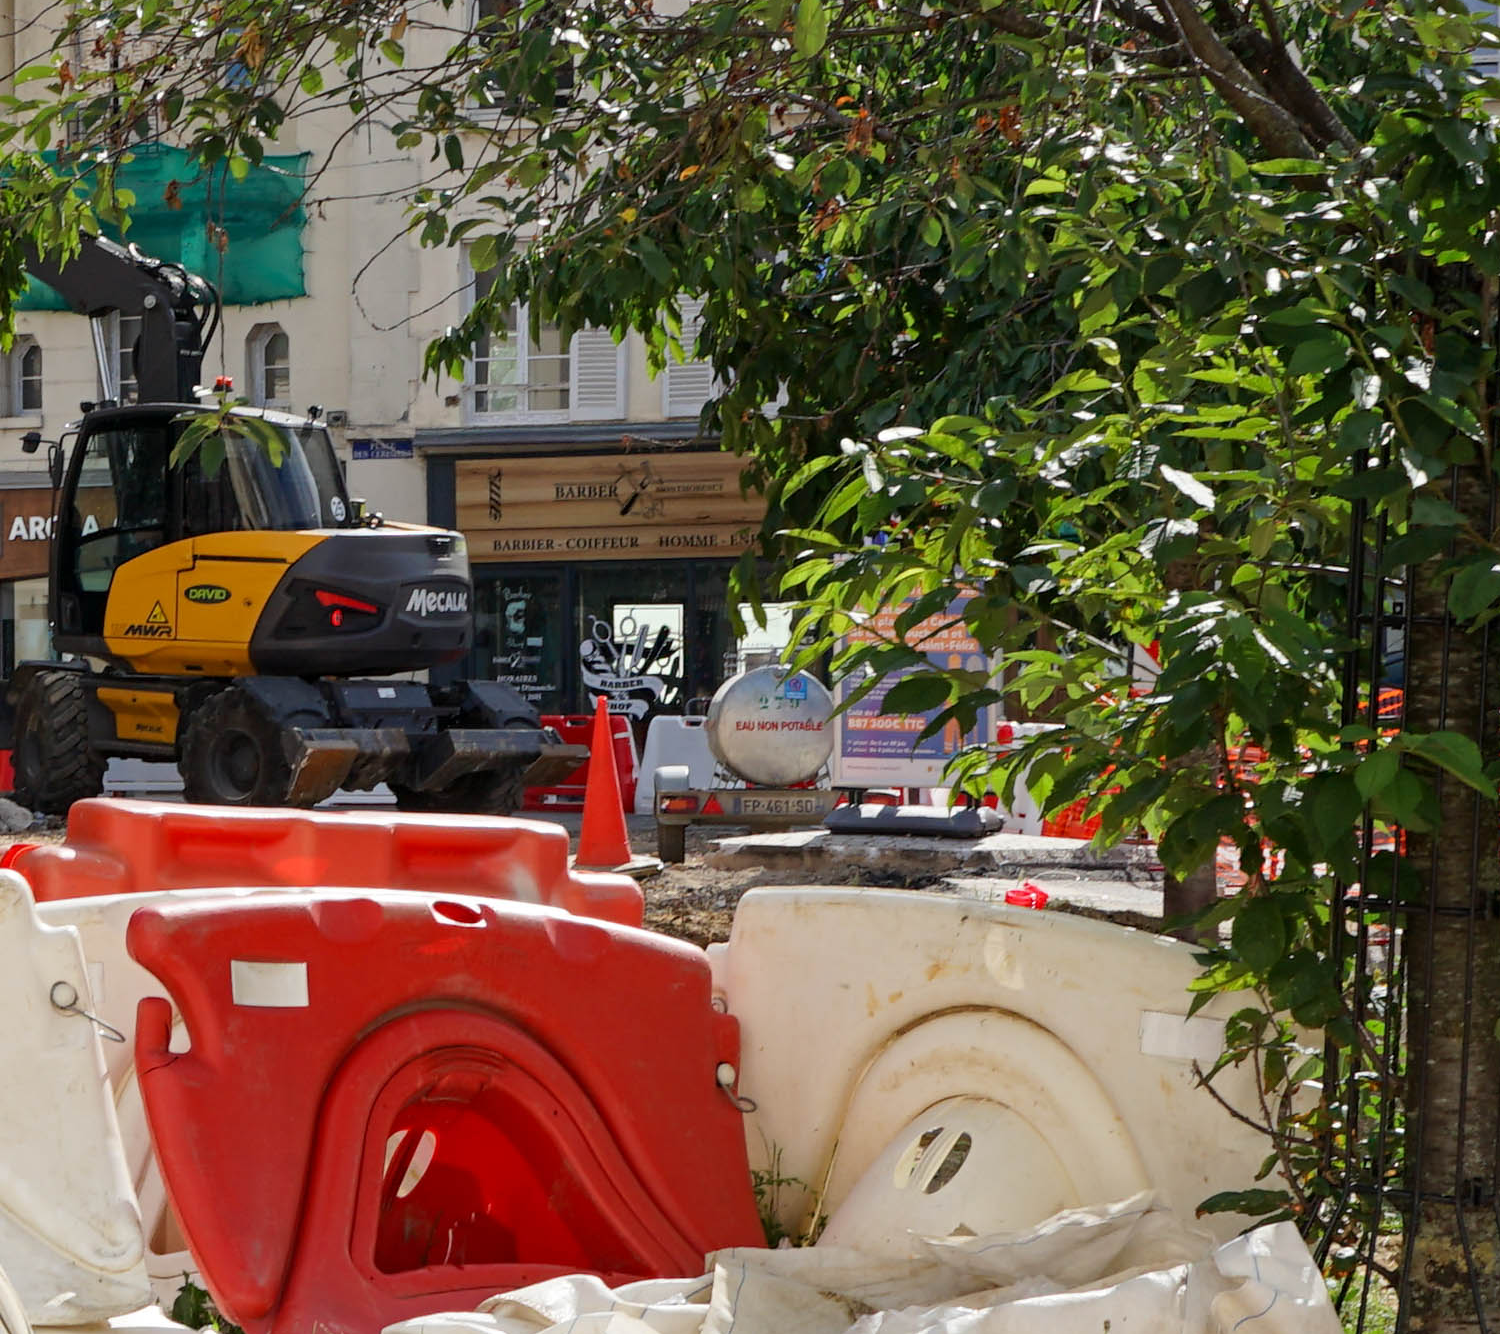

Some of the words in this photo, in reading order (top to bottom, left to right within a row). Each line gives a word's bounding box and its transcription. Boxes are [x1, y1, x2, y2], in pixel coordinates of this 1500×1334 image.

[555, 485, 618, 499] BARBER
[493, 540, 554, 552] BARBIER
[566, 536, 640, 549] COIFFEUR
[658, 534, 718, 548] HOMME
[189, 589, 227, 600] DAVID
[600, 678, 644, 688] BARBER
[736, 721, 754, 731] EAU
[757, 721, 778, 731] NON
[781, 721, 824, 731] POTABLE
[903, 719, 925, 730] TTC
